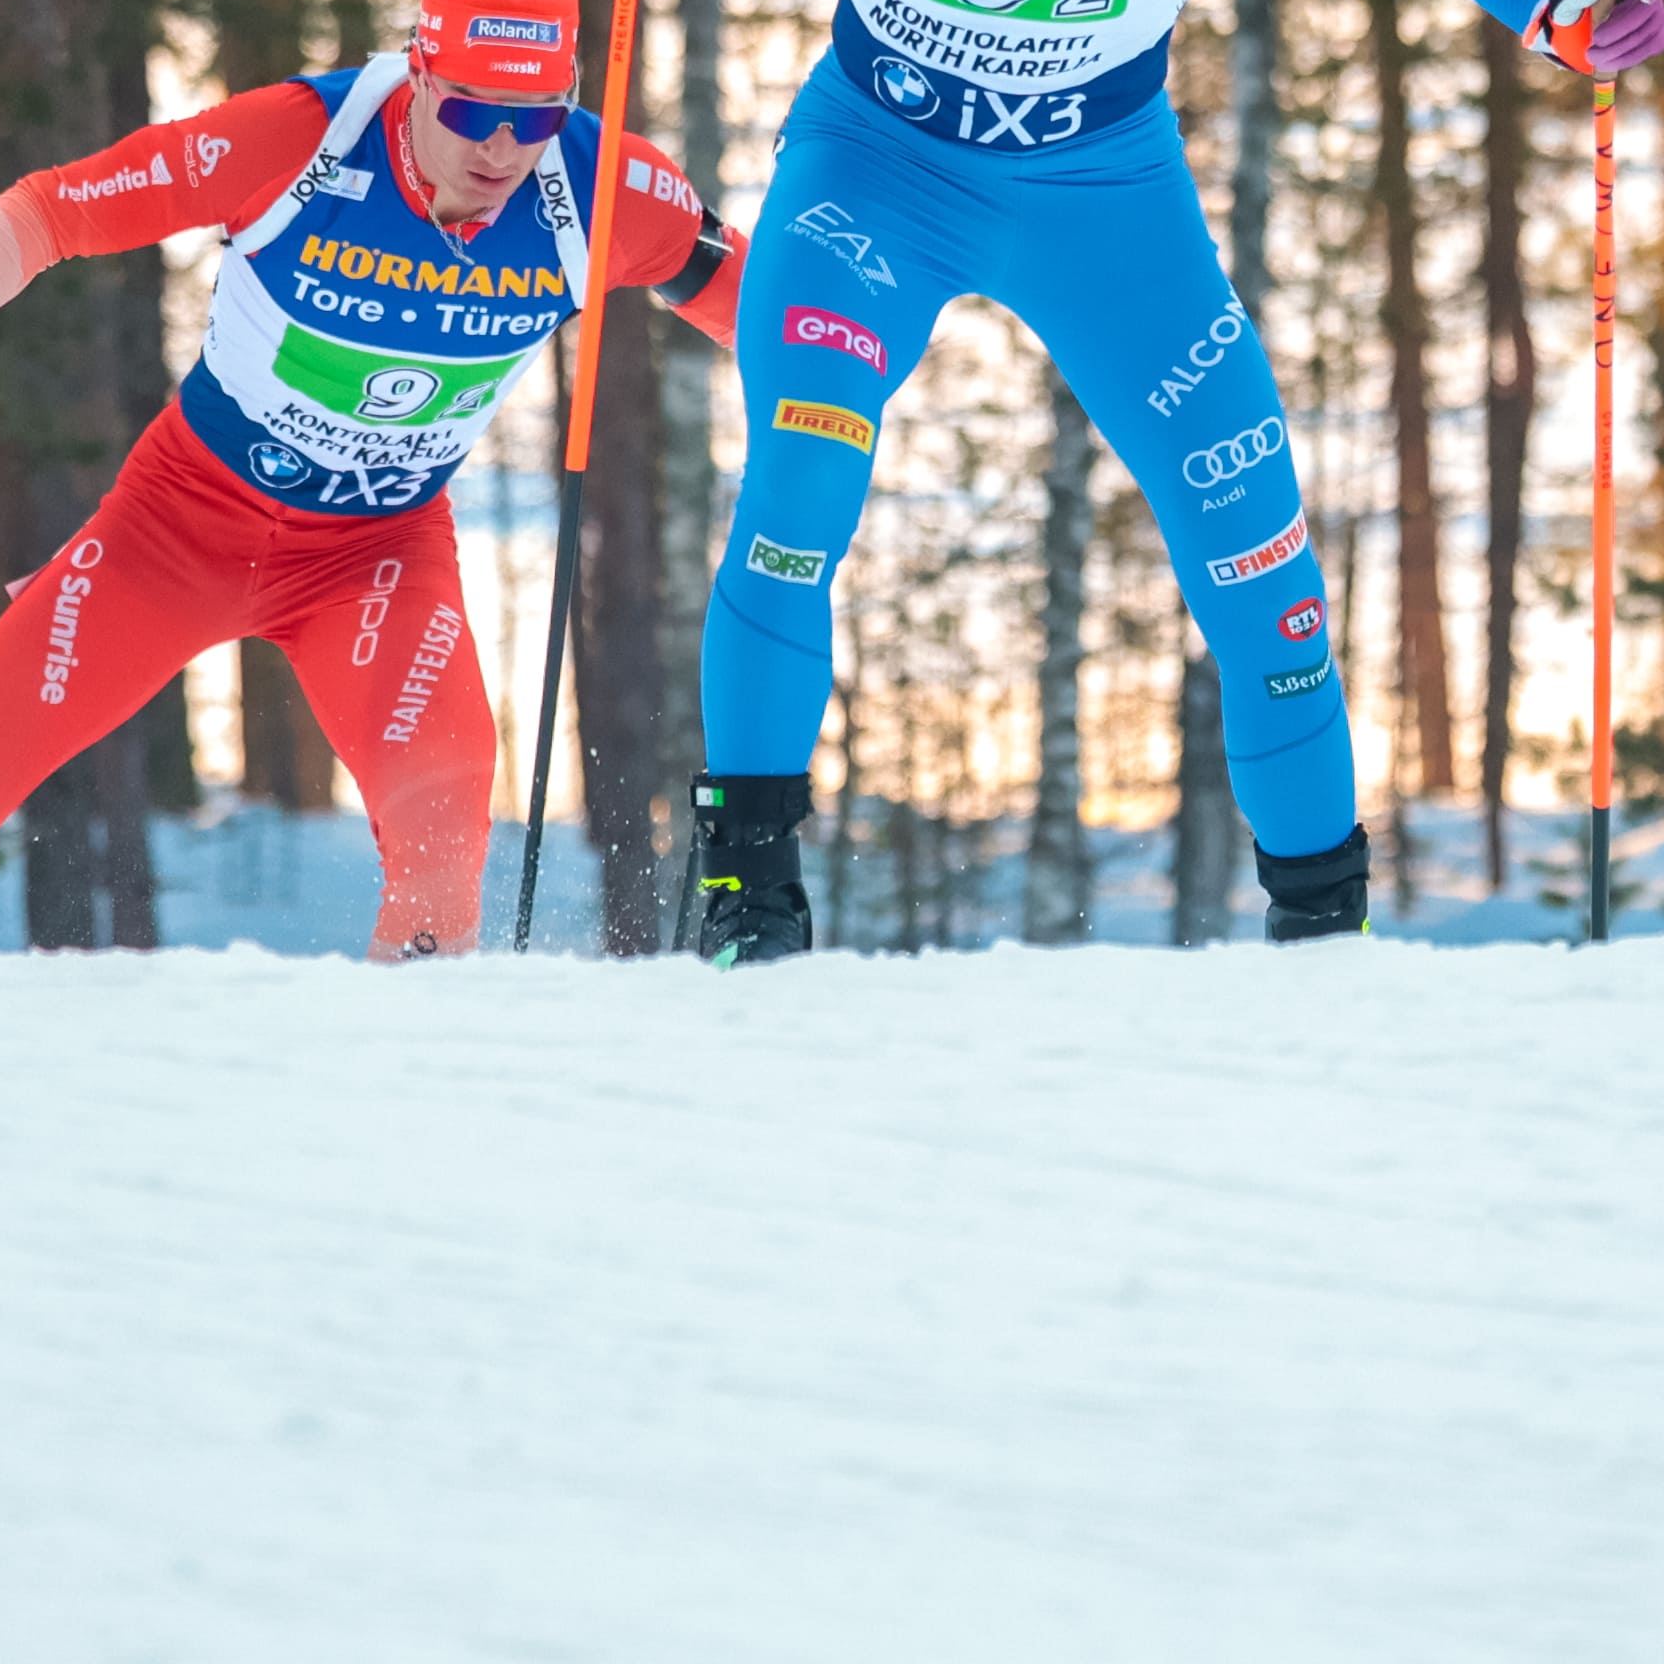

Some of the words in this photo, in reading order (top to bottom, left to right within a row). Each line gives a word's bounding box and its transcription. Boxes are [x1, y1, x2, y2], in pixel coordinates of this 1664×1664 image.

[477, 19, 537, 41] Roland
[868, 4, 966, 69] NORTH
[972, 52, 1102, 79] KARELIA
[488, 61, 542, 75] swissski
[958, 89, 1087, 147] iX3
[290, 151, 340, 205] JOKA
[539, 171, 570, 231] JOKA
[299, 234, 564, 298] HÖRMANN
[794, 200, 898, 289] EA7
[292, 271, 385, 323] Tore
[435, 303, 558, 337] Türen
[796, 316, 881, 369] enel
[354, 366, 442, 420] 9
[782, 405, 869, 444] PIRELLI
[1202, 484, 1247, 513] Audi
[40, 574, 92, 705] Sunrise
[1286, 605, 1319, 628] RTL
[383, 602, 464, 743] RAIFFEISEN
